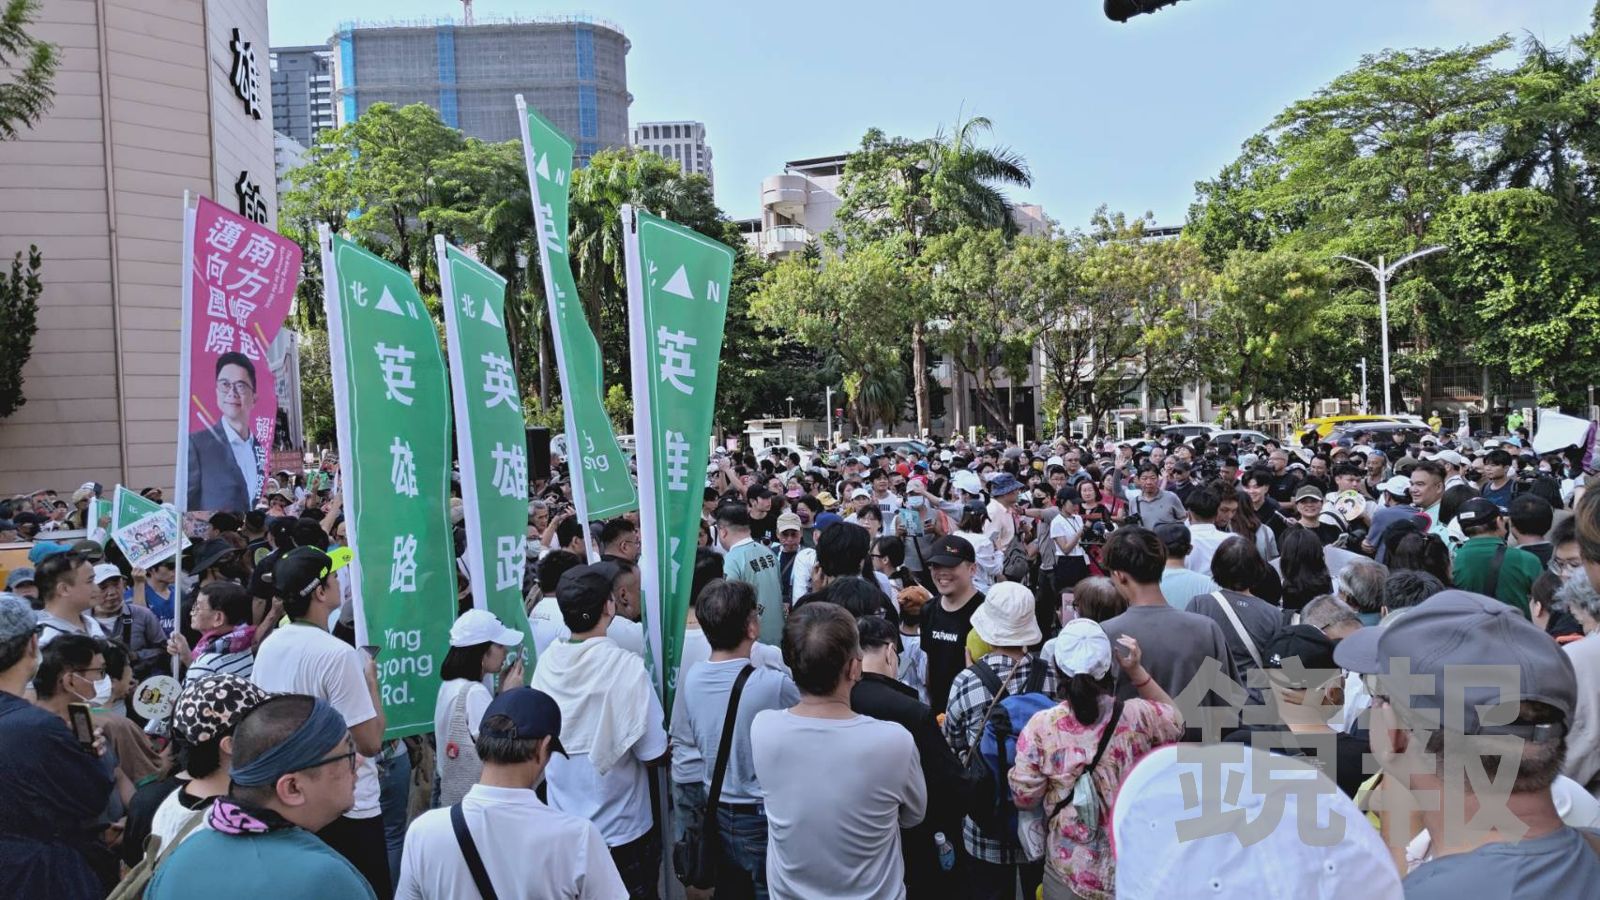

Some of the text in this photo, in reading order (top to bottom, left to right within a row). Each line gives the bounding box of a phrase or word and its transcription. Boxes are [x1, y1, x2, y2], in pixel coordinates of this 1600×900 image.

[204, 216, 247, 354] 邁向國際
[226, 232, 277, 360] 南方崛起
[350, 280, 368, 307] 北
[706, 280, 720, 303] N
[461, 293, 476, 319] 北
[373, 341, 419, 593] 英雄路
[481, 352, 528, 592] 英雄路
[384, 628, 421, 652] Ying
[381, 681, 415, 707] Rd.
